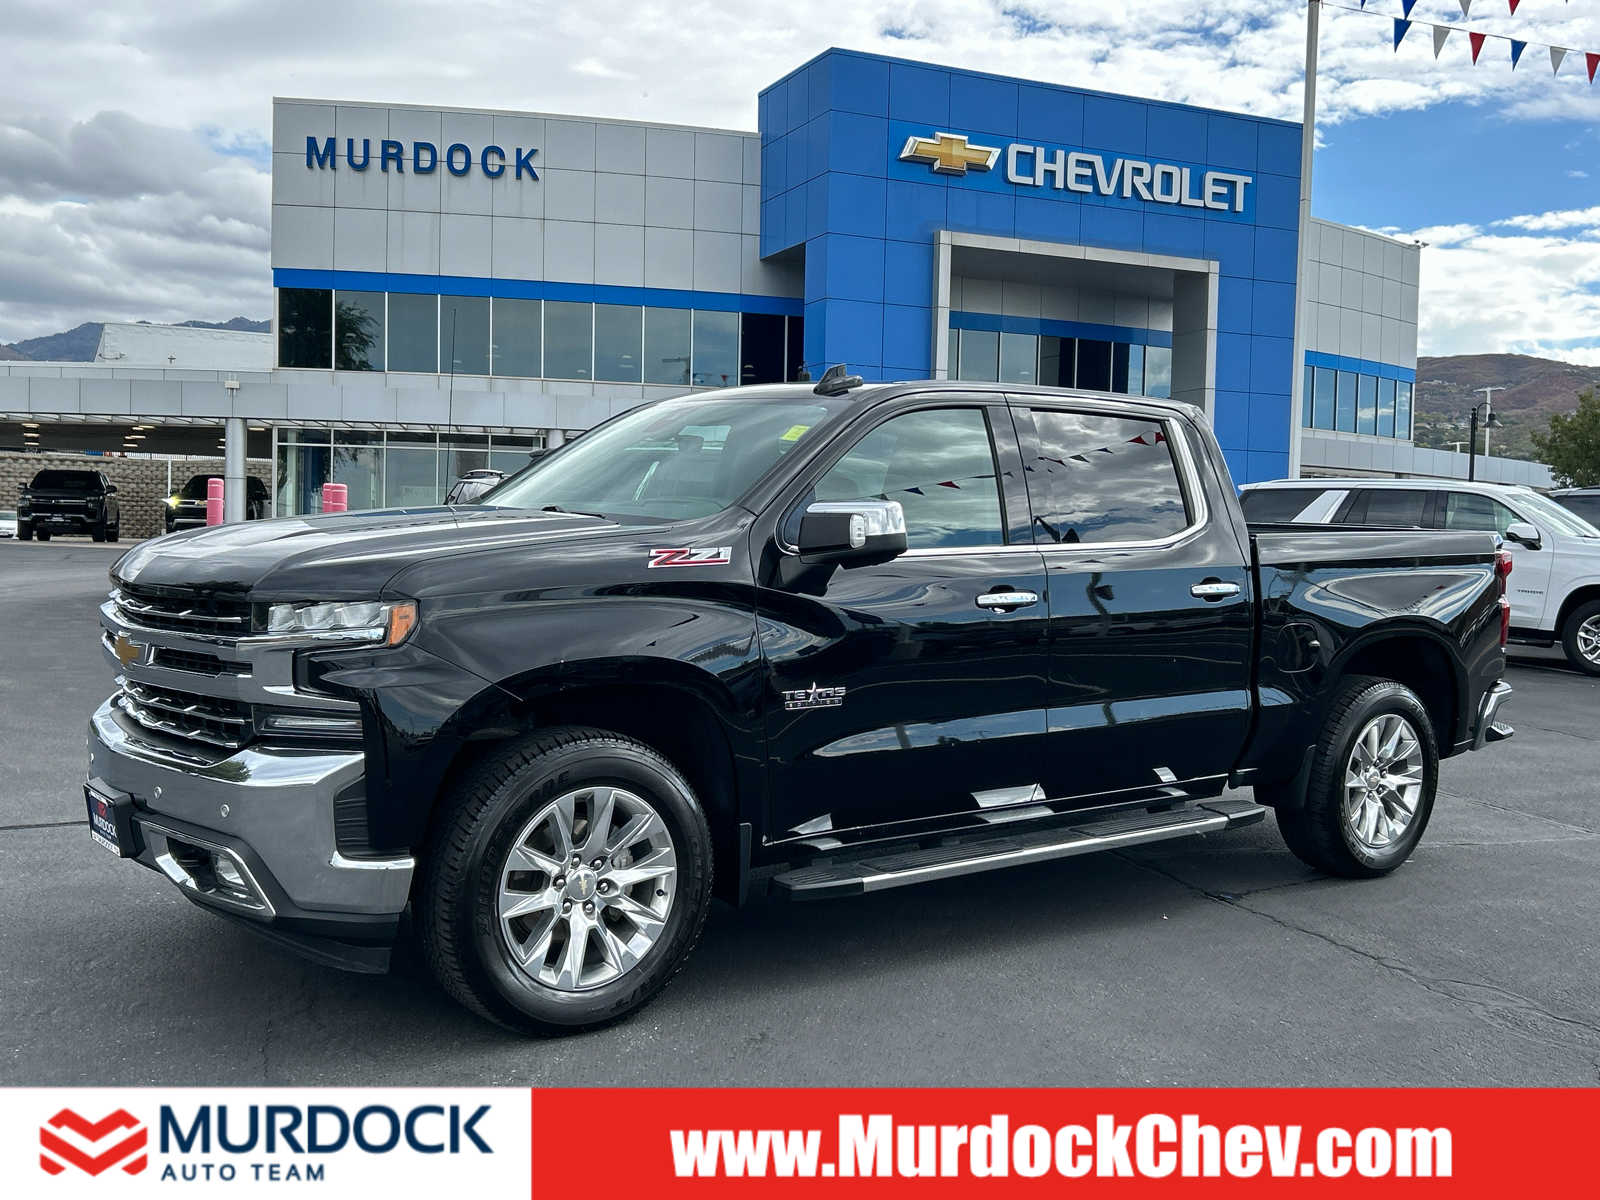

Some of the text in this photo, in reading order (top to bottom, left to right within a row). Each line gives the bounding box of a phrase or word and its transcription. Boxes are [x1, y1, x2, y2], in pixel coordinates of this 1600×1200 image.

[306, 136, 538, 180] MURDOCK
[1007, 143, 1253, 212] CHEVROLET
[648, 547, 732, 568] Z71
